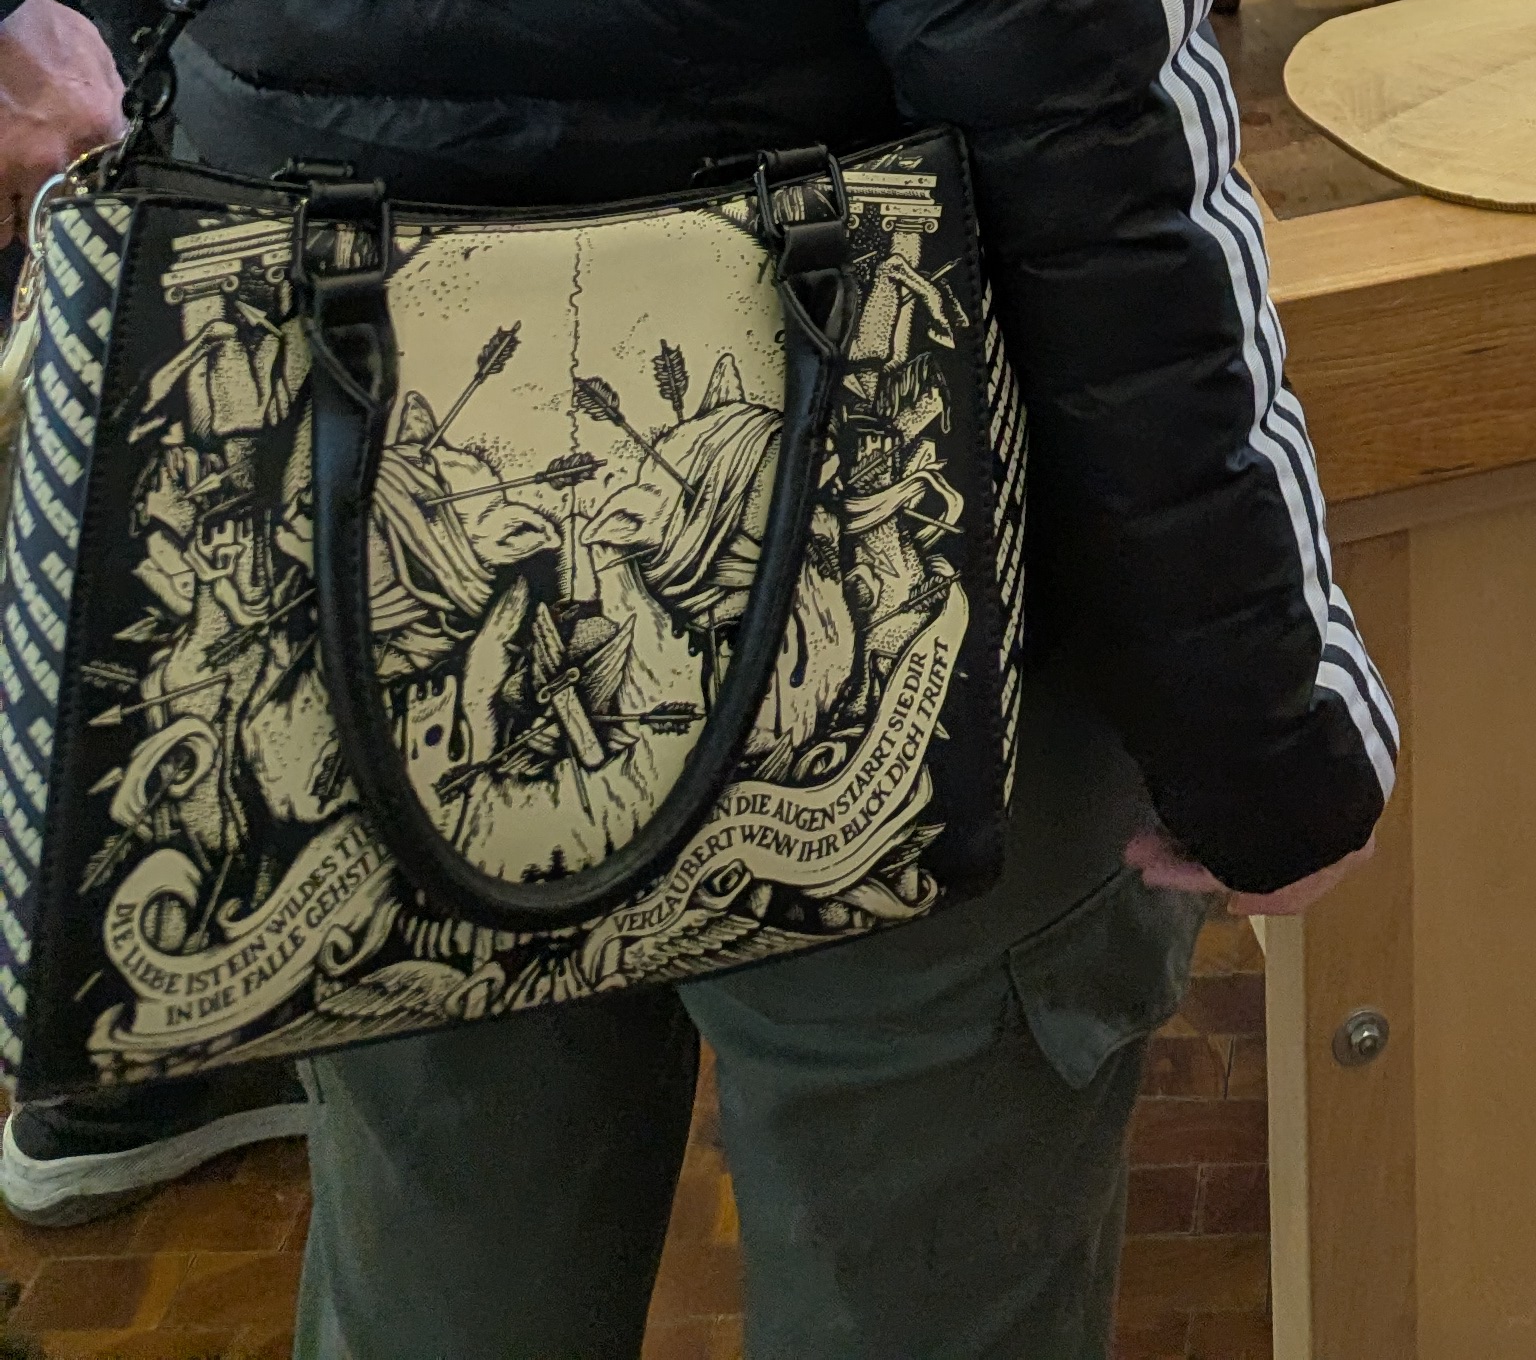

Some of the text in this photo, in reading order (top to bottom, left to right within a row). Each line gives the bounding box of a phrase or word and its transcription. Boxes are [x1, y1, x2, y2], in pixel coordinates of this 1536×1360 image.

[613, 636, 949, 933] VERZAUBERT WENN IHR BLICK DICH TRIFFT
[734, 793, 772, 816] DIE
[771, 798, 837, 832] AUGEN
[836, 730, 896, 816] STARRT
[888, 692, 915, 733] SIE
[903, 651, 928, 694] DIR
[166, 1002, 193, 1026] IN
[199, 985, 237, 1018] DIE
[243, 925, 306, 996] FALLE
[305, 851, 372, 930] GEHST
[185, 963, 226, 996] IST
[227, 933, 267, 976] EIN
[266, 854, 338, 935] WILDES
